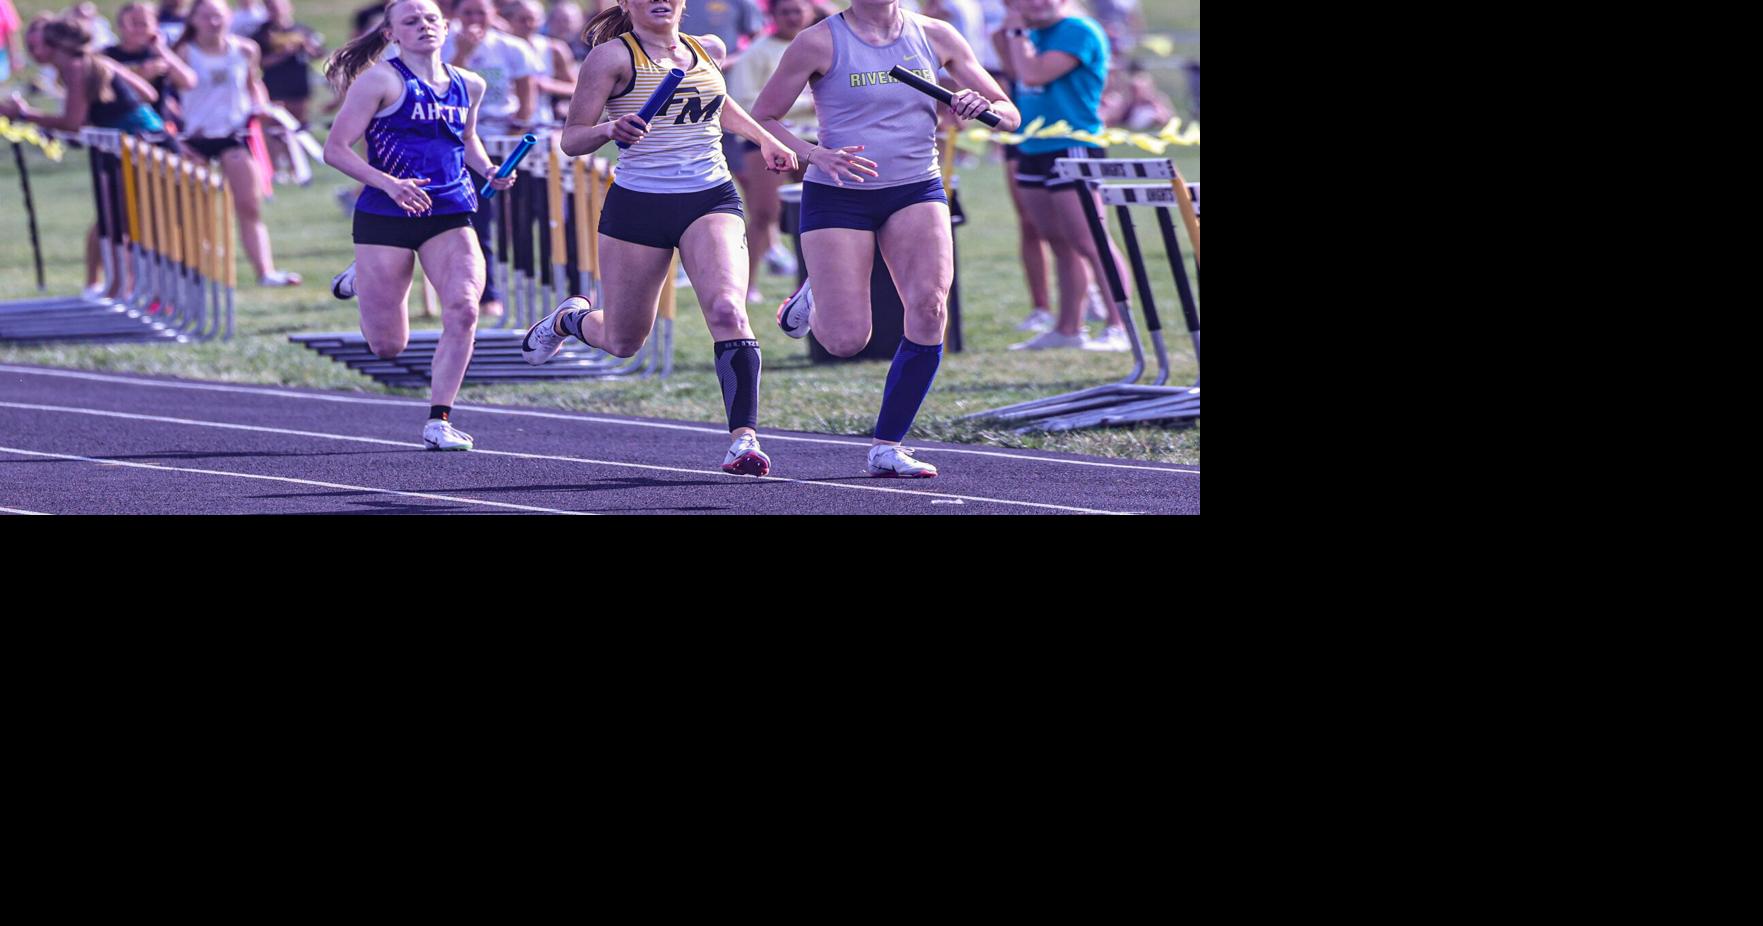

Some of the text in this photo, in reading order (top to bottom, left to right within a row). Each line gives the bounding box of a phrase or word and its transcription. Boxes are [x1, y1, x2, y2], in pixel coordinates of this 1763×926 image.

[849, 69, 932, 88] RIVERDE
[410, 102, 469, 124] AHTW
[655, 87, 725, 125] FM
